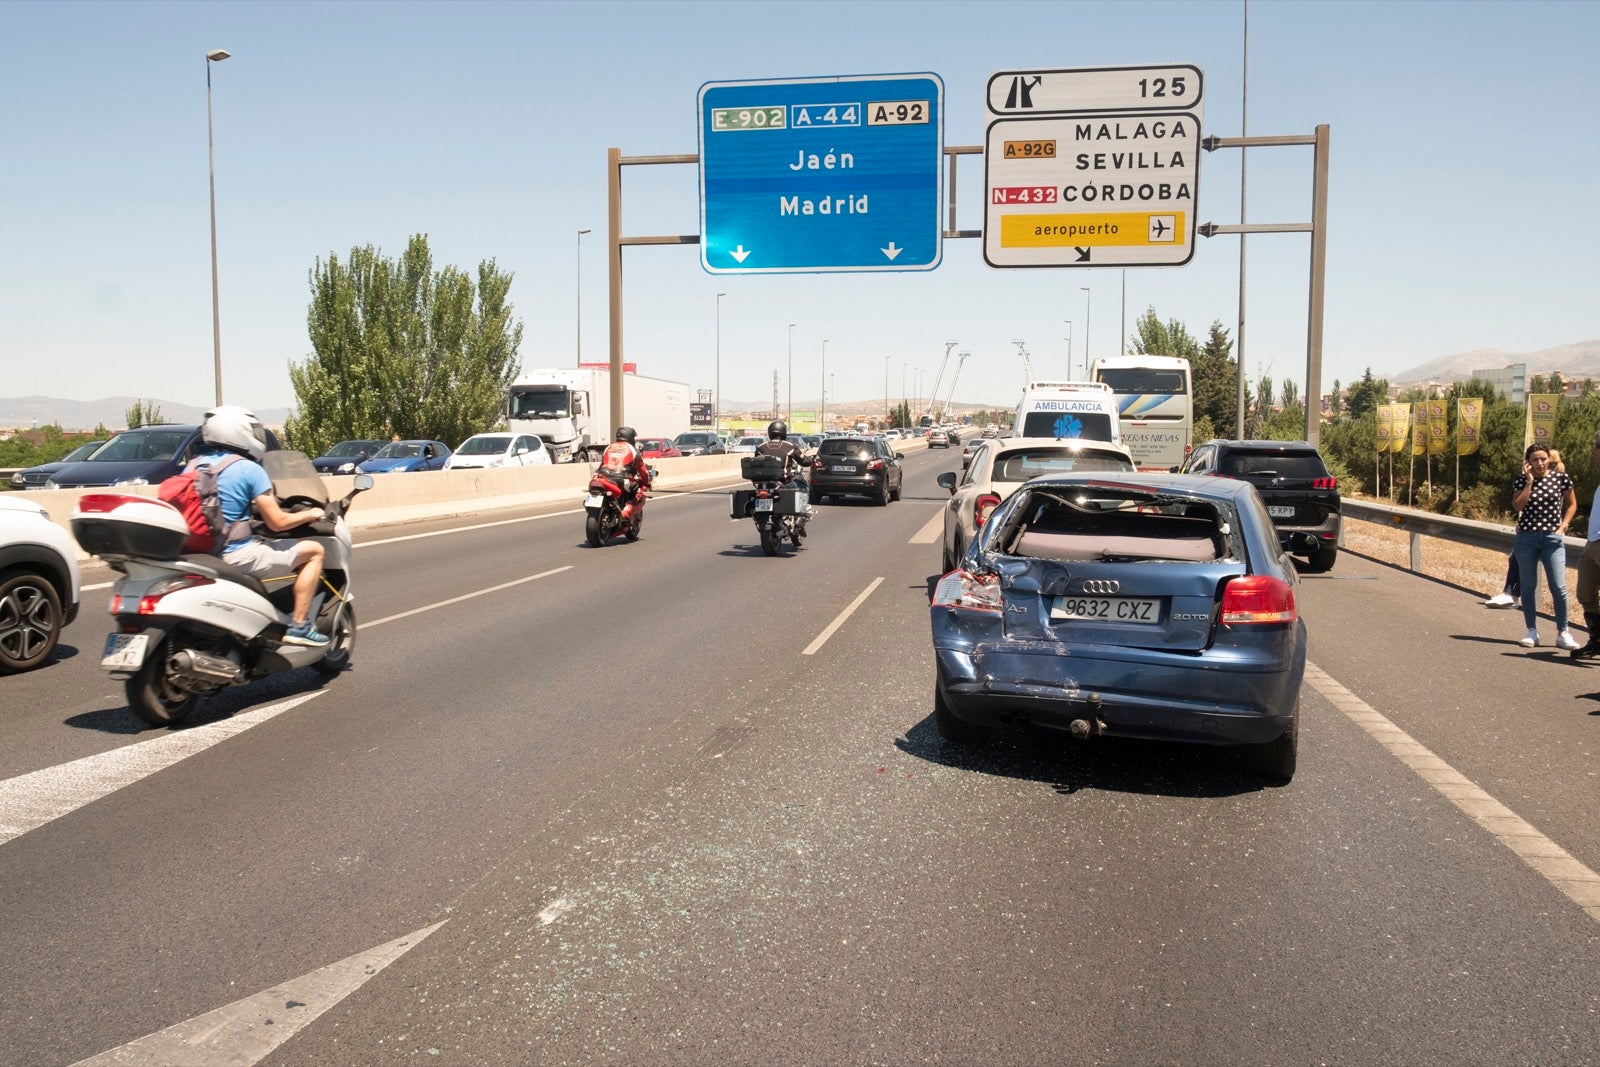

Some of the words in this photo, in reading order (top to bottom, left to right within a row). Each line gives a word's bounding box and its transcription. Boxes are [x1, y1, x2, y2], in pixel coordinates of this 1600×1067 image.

[1138, 77, 1186, 98] 125
[715, 109, 783, 128] E-902
[796, 107, 857, 125] A-44
[874, 104, 923, 122] A-92
[1075, 121, 1187, 141] MALAGA
[789, 148, 854, 171] Jaén
[1006, 143, 1055, 156] A-92G
[1075, 151, 1185, 170] SEVILLA
[994, 189, 1056, 203] N-432
[1063, 181, 1191, 202] CÓRDOBA
[780, 194, 869, 216] Madrid
[1035, 223, 1119, 238] aeropuerto
[1034, 402, 1103, 412] AMBULANCIA
[1065, 599, 1111, 618] 9632
[1116, 601, 1153, 620] CXZ
